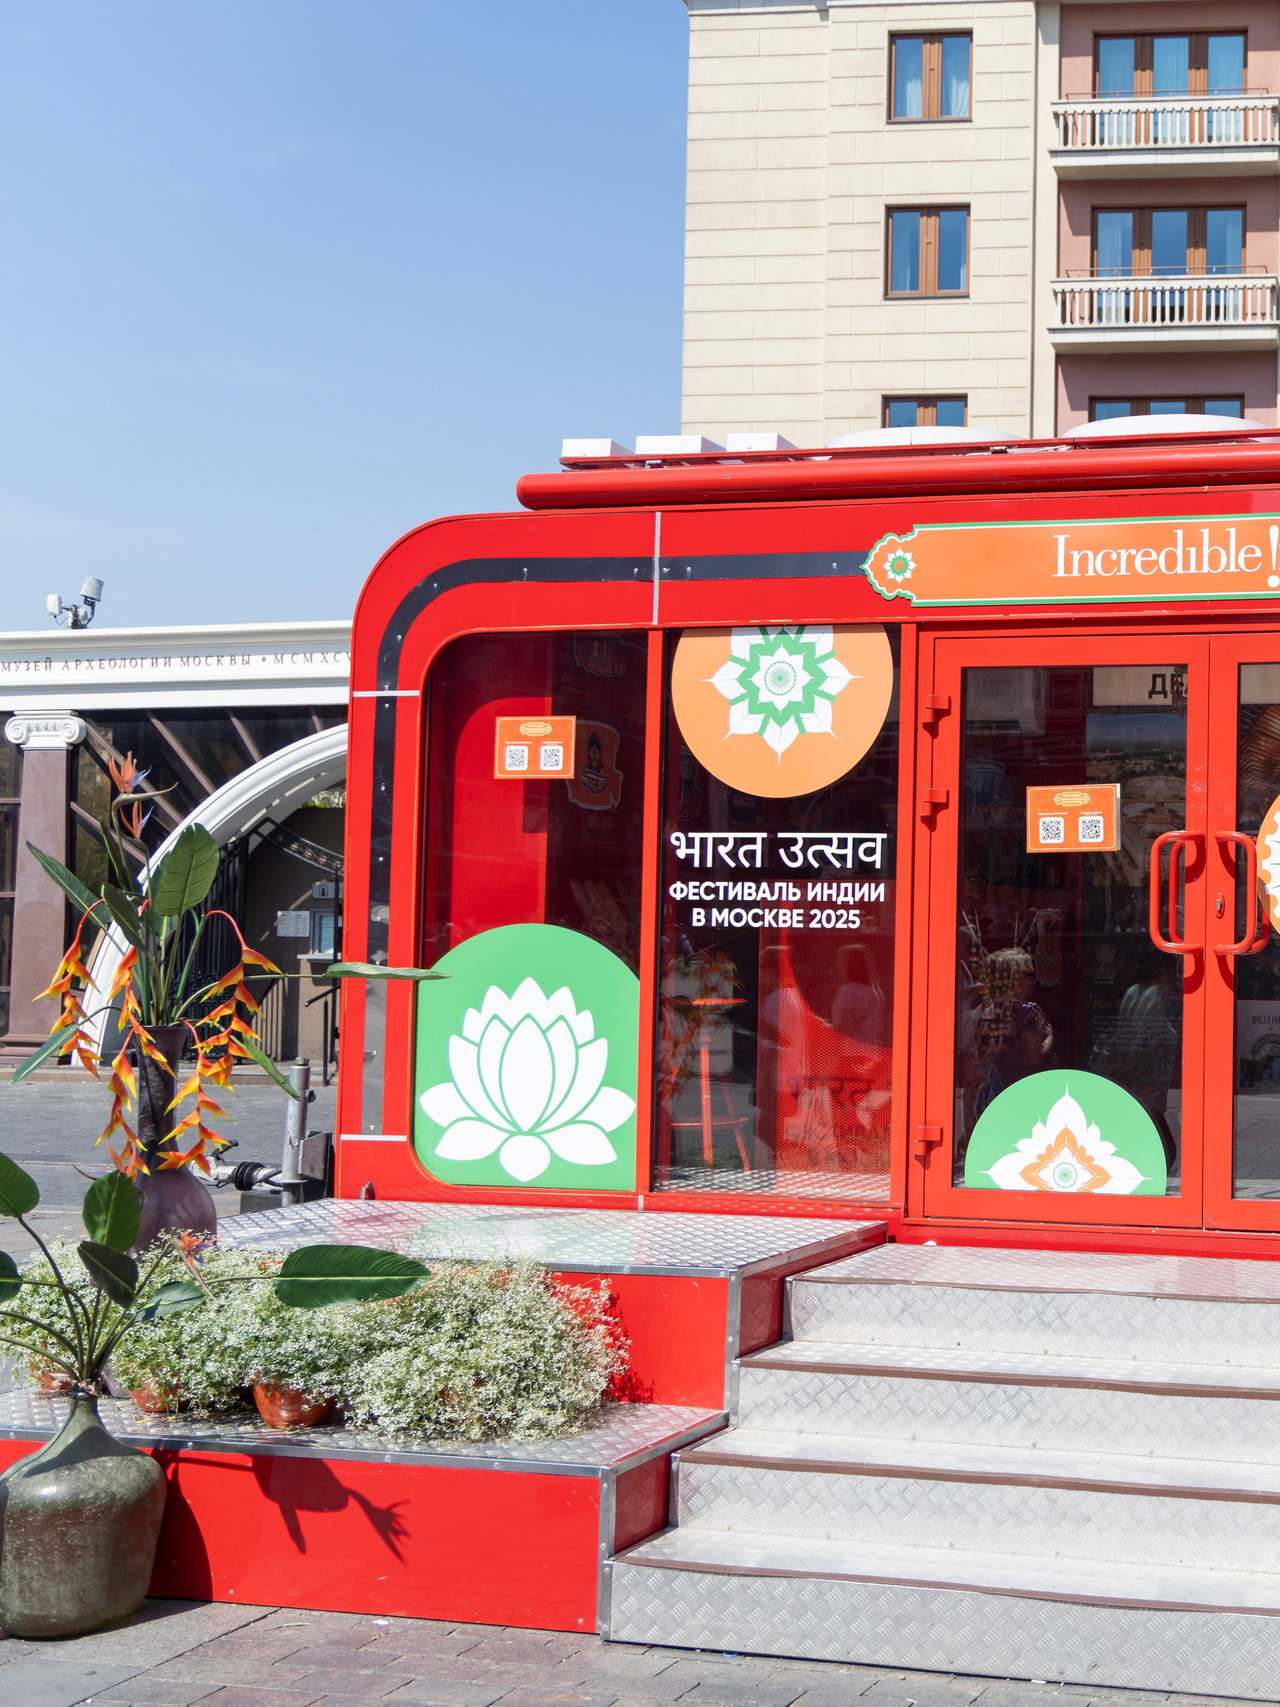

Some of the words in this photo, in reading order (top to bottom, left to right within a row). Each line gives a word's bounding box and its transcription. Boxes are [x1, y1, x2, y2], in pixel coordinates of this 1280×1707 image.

[1053, 528, 1261, 577] Incredible
[1, 656, 53, 672] МУЗЕЙ
[61, 656, 172, 671] АРХЕОЛОГИИ
[180, 654, 251, 667] МОСКВЫ
[670, 832, 767, 868] भारत
[777, 832, 887, 870] उत्सव
[669, 881, 801, 902] ФЕСТИВАЛЬ
[807, 881, 885, 906] ИНДИИ
[692, 909, 705, 927] В
[711, 908, 804, 928] МОСКВЕ
[809, 908, 861, 929] 2025
[1252, 1015, 1270, 1024] DILLI
